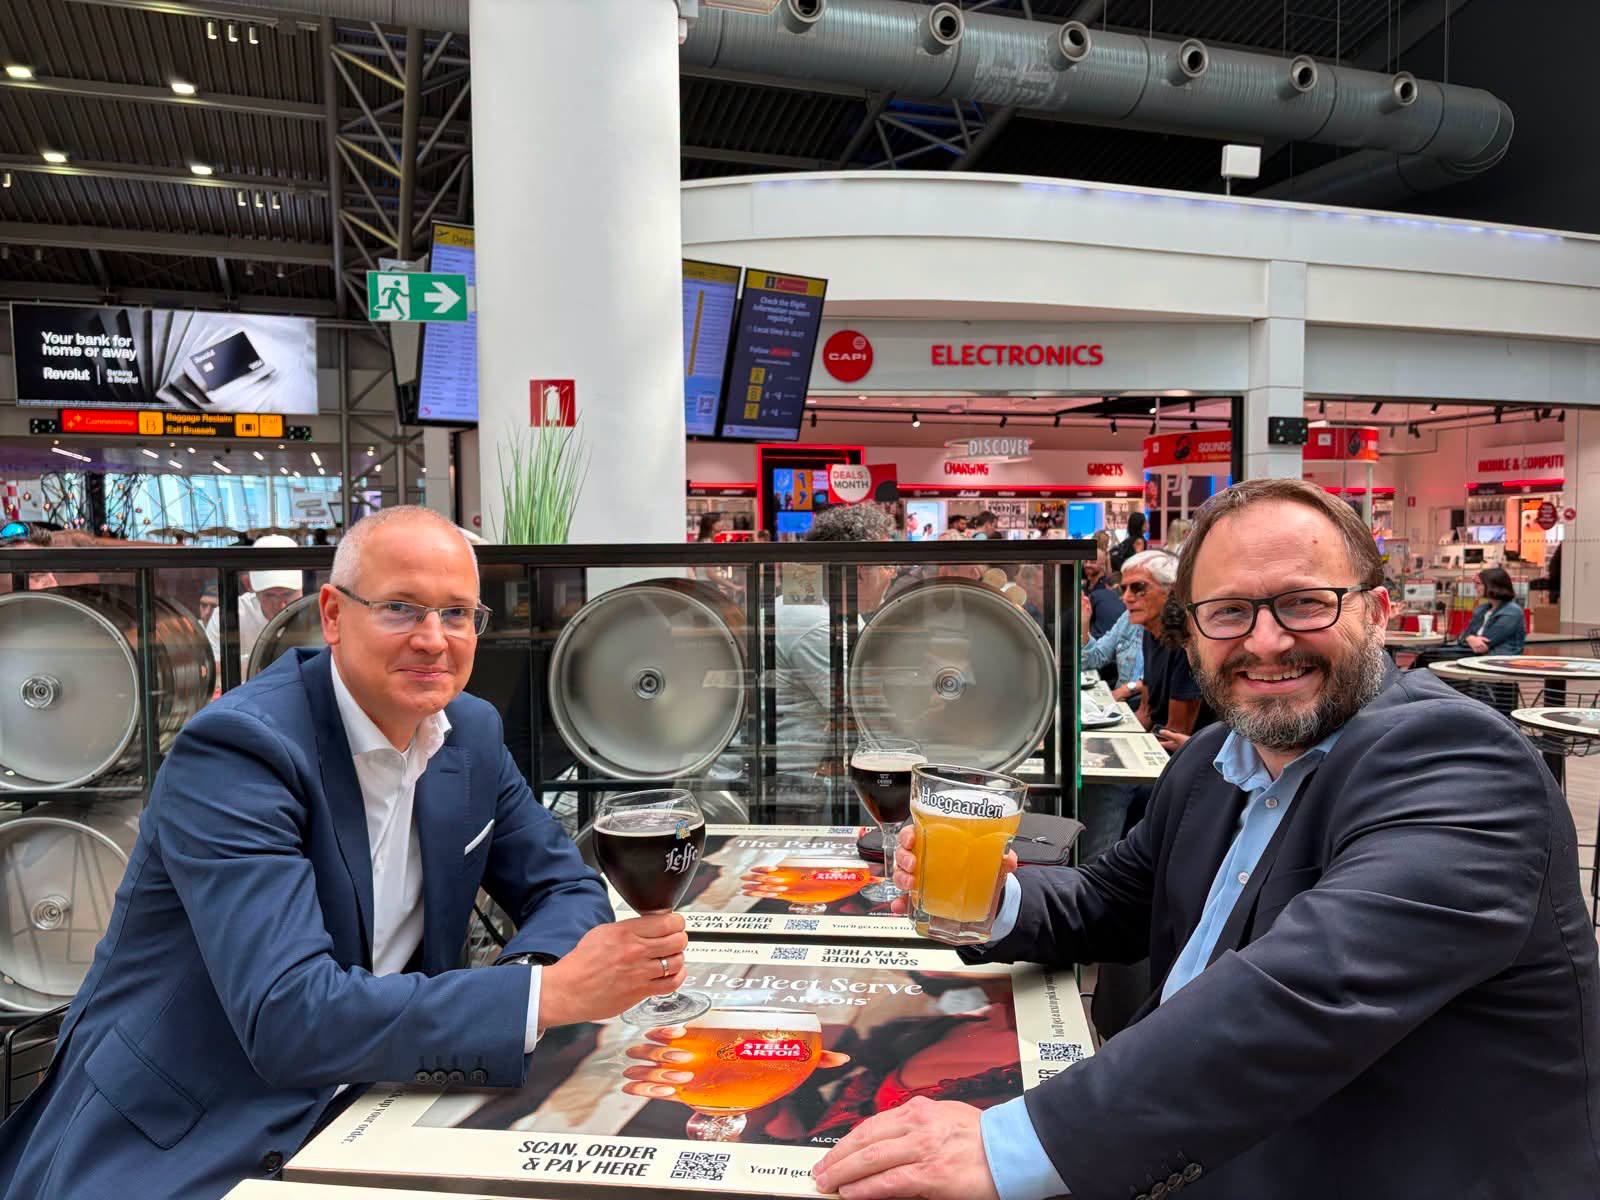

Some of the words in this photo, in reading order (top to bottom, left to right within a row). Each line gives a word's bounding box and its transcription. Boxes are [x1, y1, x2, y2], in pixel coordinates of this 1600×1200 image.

[41, 331, 74, 345] Your
[75, 332, 110, 347] bank
[112, 334, 132, 348] for
[42, 343, 82, 357] home
[84, 347, 100, 357] or
[102, 348, 137, 362] away
[829, 353, 867, 361] CAPI
[931, 344, 1104, 367] ELECTRONICS
[43, 366, 91, 381] Revolut
[165, 412, 201, 424] Baggage
[969, 439, 1029, 456] DISCOVER
[944, 462, 989, 475] CHARGING
[1087, 463, 1124, 476] GADGETS
[1478, 458, 1511, 472] MOBILE
[1512, 458, 1520, 471] &
[833, 471, 864, 480] DEALS
[834, 480, 869, 489] MONTH
[920, 784, 1004, 818] Hoegaarden
[736, 839, 778, 848] The
[784, 840, 858, 849] Perfec
[664, 842, 698, 875] Leffe
[729, 915, 774, 923] ORDER
[824, 948, 860, 956] HERE
[863, 949, 893, 957] PAY
[822, 955, 871, 964] ORDER
[703, 972, 822, 990] Perfect
[829, 977, 924, 996] Serve
[518, 1140, 579, 1157] SCAN,
[586, 1143, 658, 1160] ORDER
[521, 1157, 541, 1171] &
[543, 1158, 591, 1173] PAY
[592, 1161, 651, 1177] HERE
[750, 1165, 788, 1176] You'll
